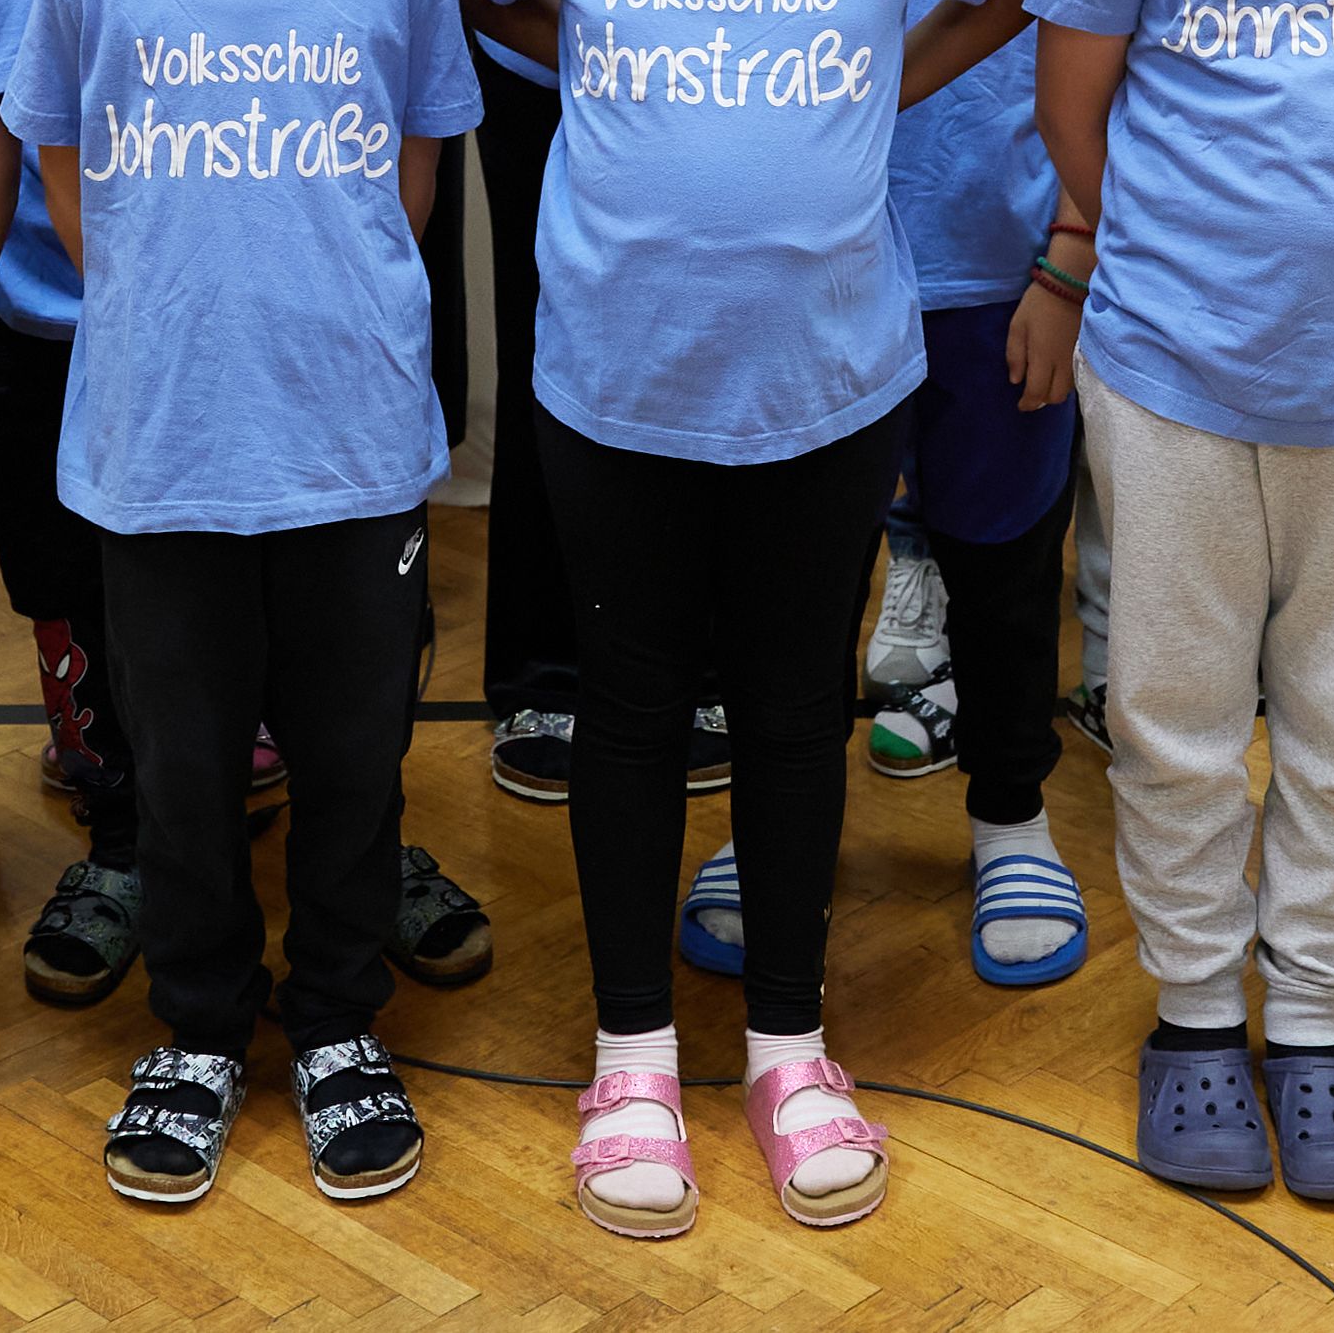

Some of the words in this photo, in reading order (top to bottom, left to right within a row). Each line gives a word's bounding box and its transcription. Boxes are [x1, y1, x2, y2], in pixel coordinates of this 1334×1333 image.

[135, 29, 361, 86] Volksschule
[572, 22, 872, 108] Johnstraße
[83, 97, 393, 182] Johnstraße
